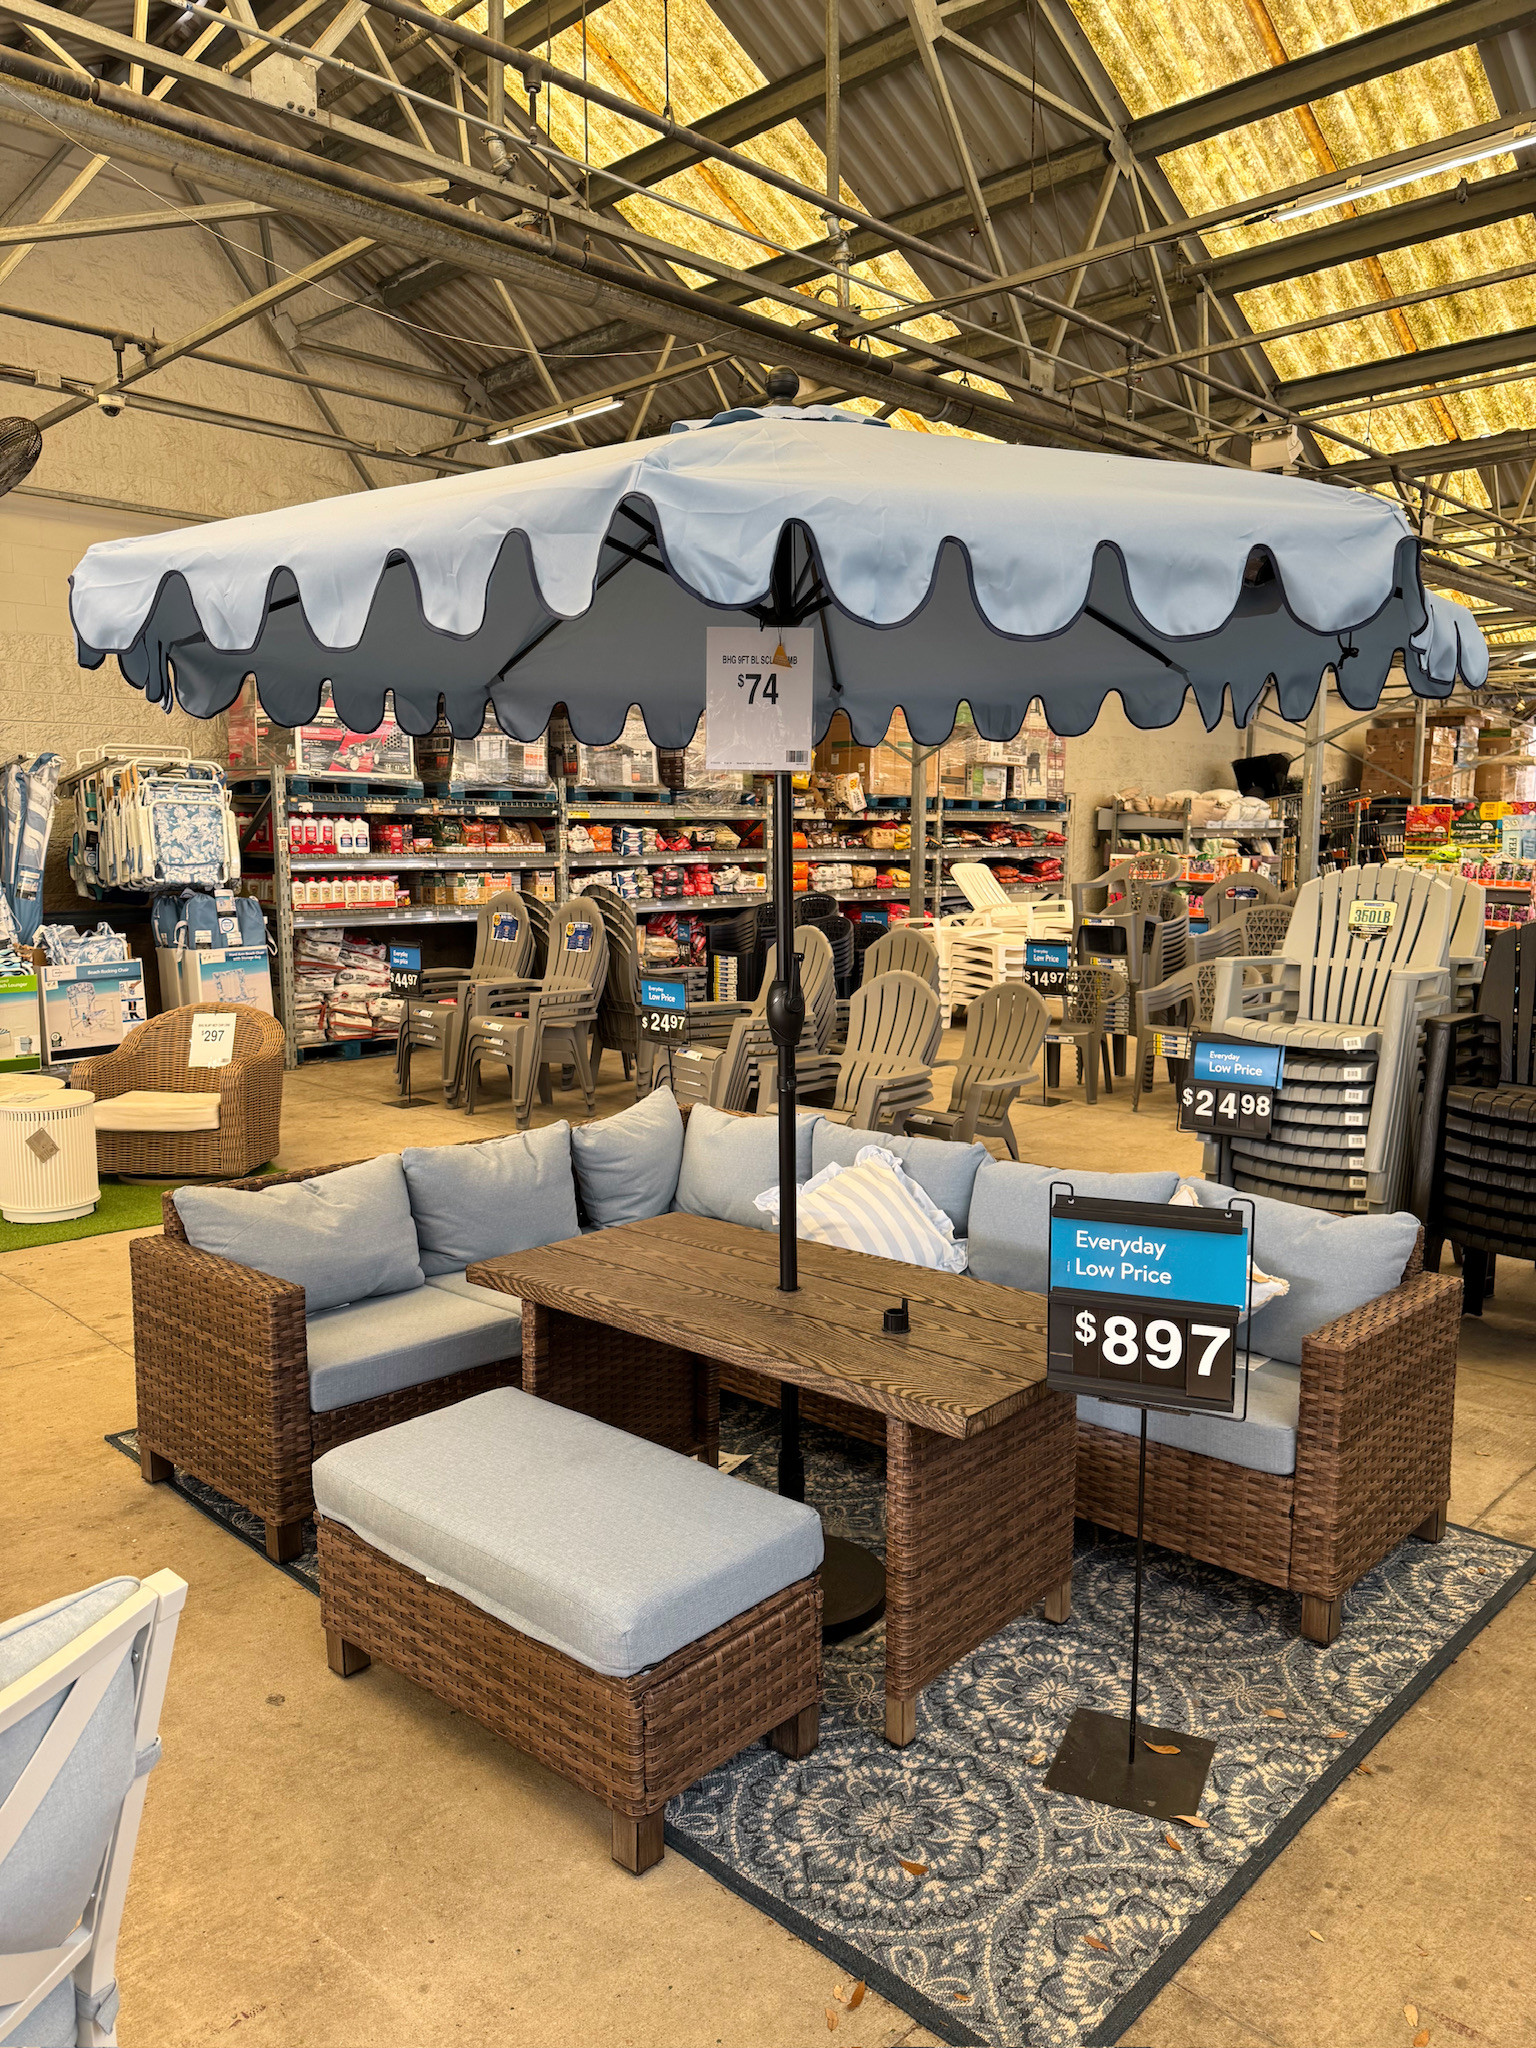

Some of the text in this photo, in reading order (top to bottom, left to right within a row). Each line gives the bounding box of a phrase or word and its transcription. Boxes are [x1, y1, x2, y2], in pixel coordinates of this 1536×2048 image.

[722, 655, 736, 665] BHG
[738, 655, 750, 665] 9FT
[751, 655, 760, 665] BL
[737, 672, 779, 705] $74
[1508, 838, 1518, 858] FERR
[1045, 954, 1060, 963] Price
[390, 972, 418, 988] $4497
[1025, 970, 1064, 986] $1497
[648, 992, 676, 1003] Low Price
[641, 1012, 685, 1032] $2497
[201, 1030, 224, 1042] $297
[1209, 1050, 1240, 1062] Everyday
[1208, 1061, 1263, 1076] Low Price
[1182, 1087, 1270, 1120] $2498
[1076, 1230, 1166, 1260] Everyday
[1076, 1258, 1115, 1278] Low
[1120, 1262, 1172, 1284] Price
[1074, 1310, 1231, 1377] $897
